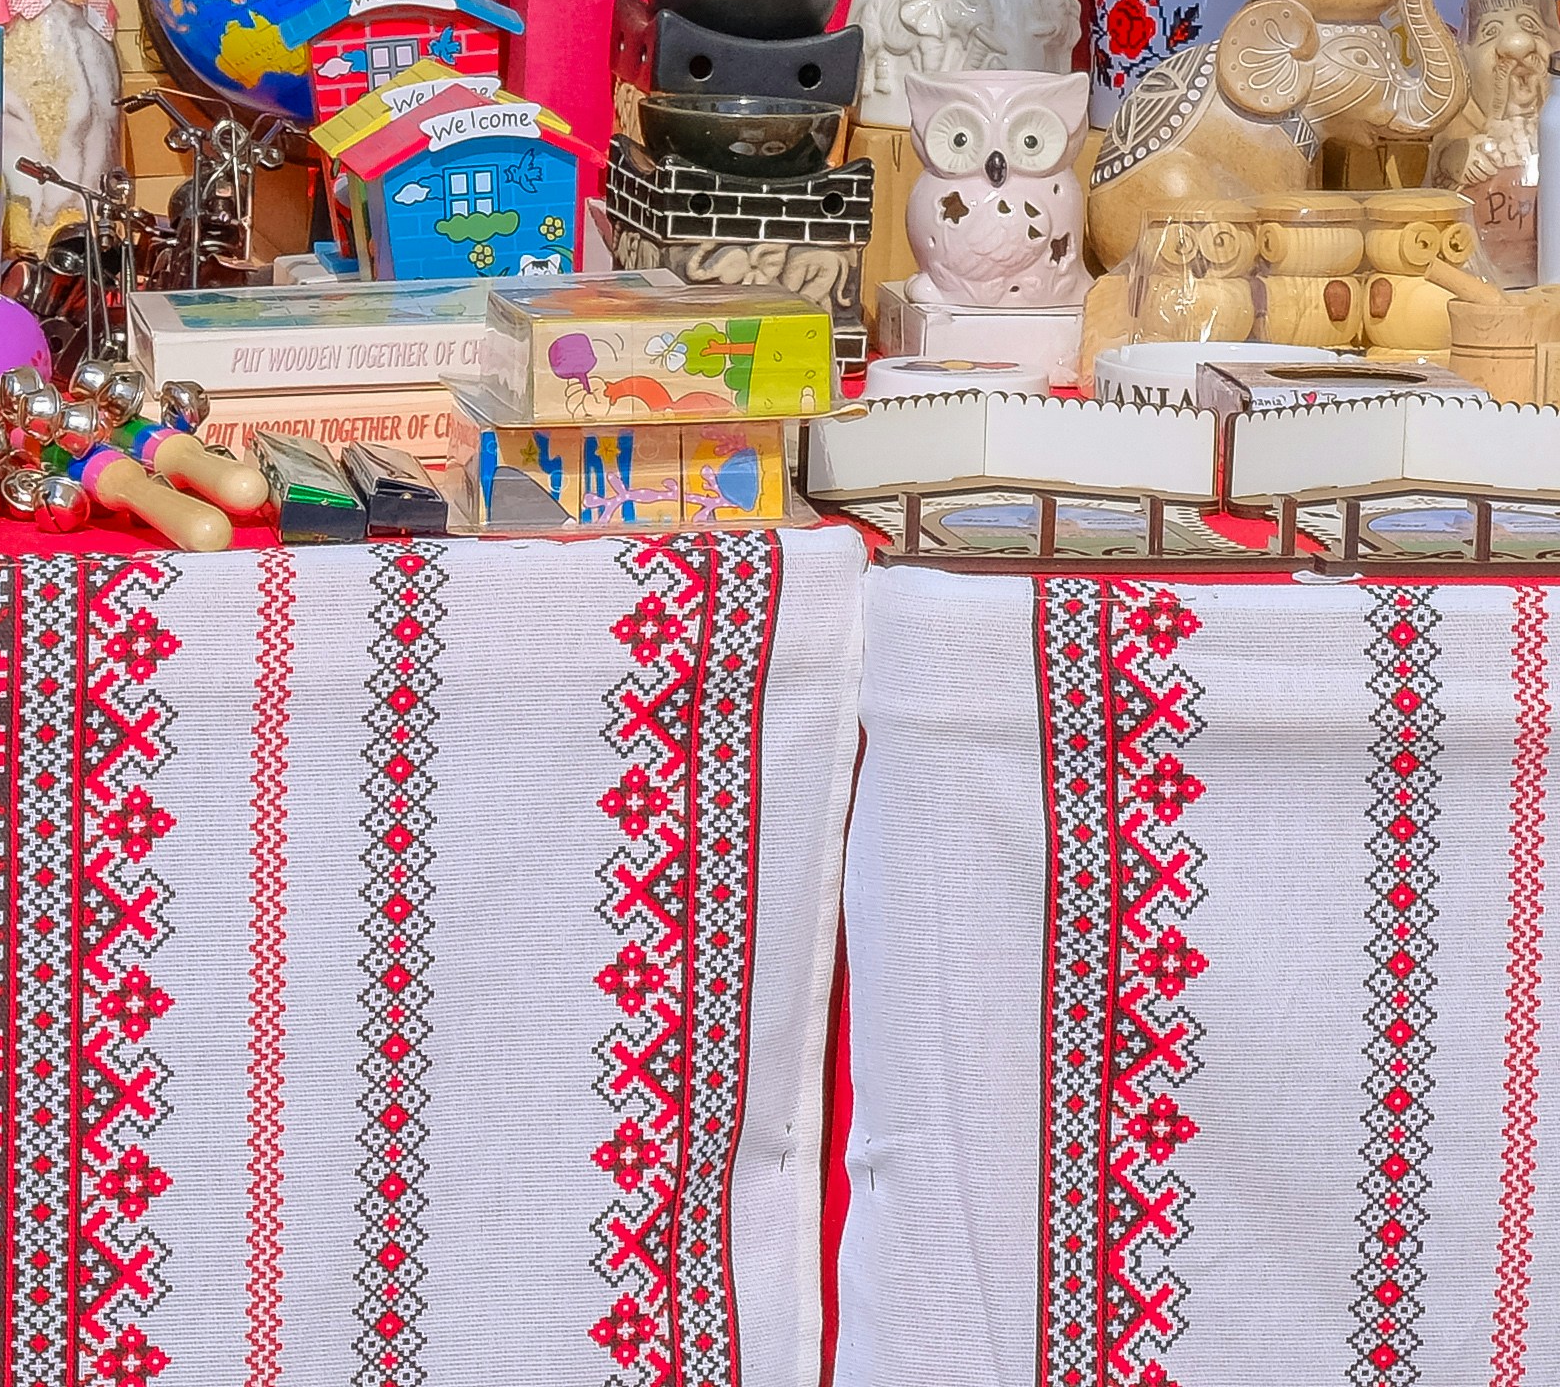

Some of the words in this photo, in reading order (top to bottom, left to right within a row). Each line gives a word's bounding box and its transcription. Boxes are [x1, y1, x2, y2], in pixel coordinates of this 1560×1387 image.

[432, 110, 532, 141] Welcome
[231, 346, 265, 373] PUT
[268, 344, 342, 371] WOODEN
[347, 341, 429, 369] TOGETHER
[434, 339, 456, 365] OF
[206, 422, 239, 445] PUT
[320, 415, 400, 443] TOGETHER
[408, 414, 431, 439] OF
